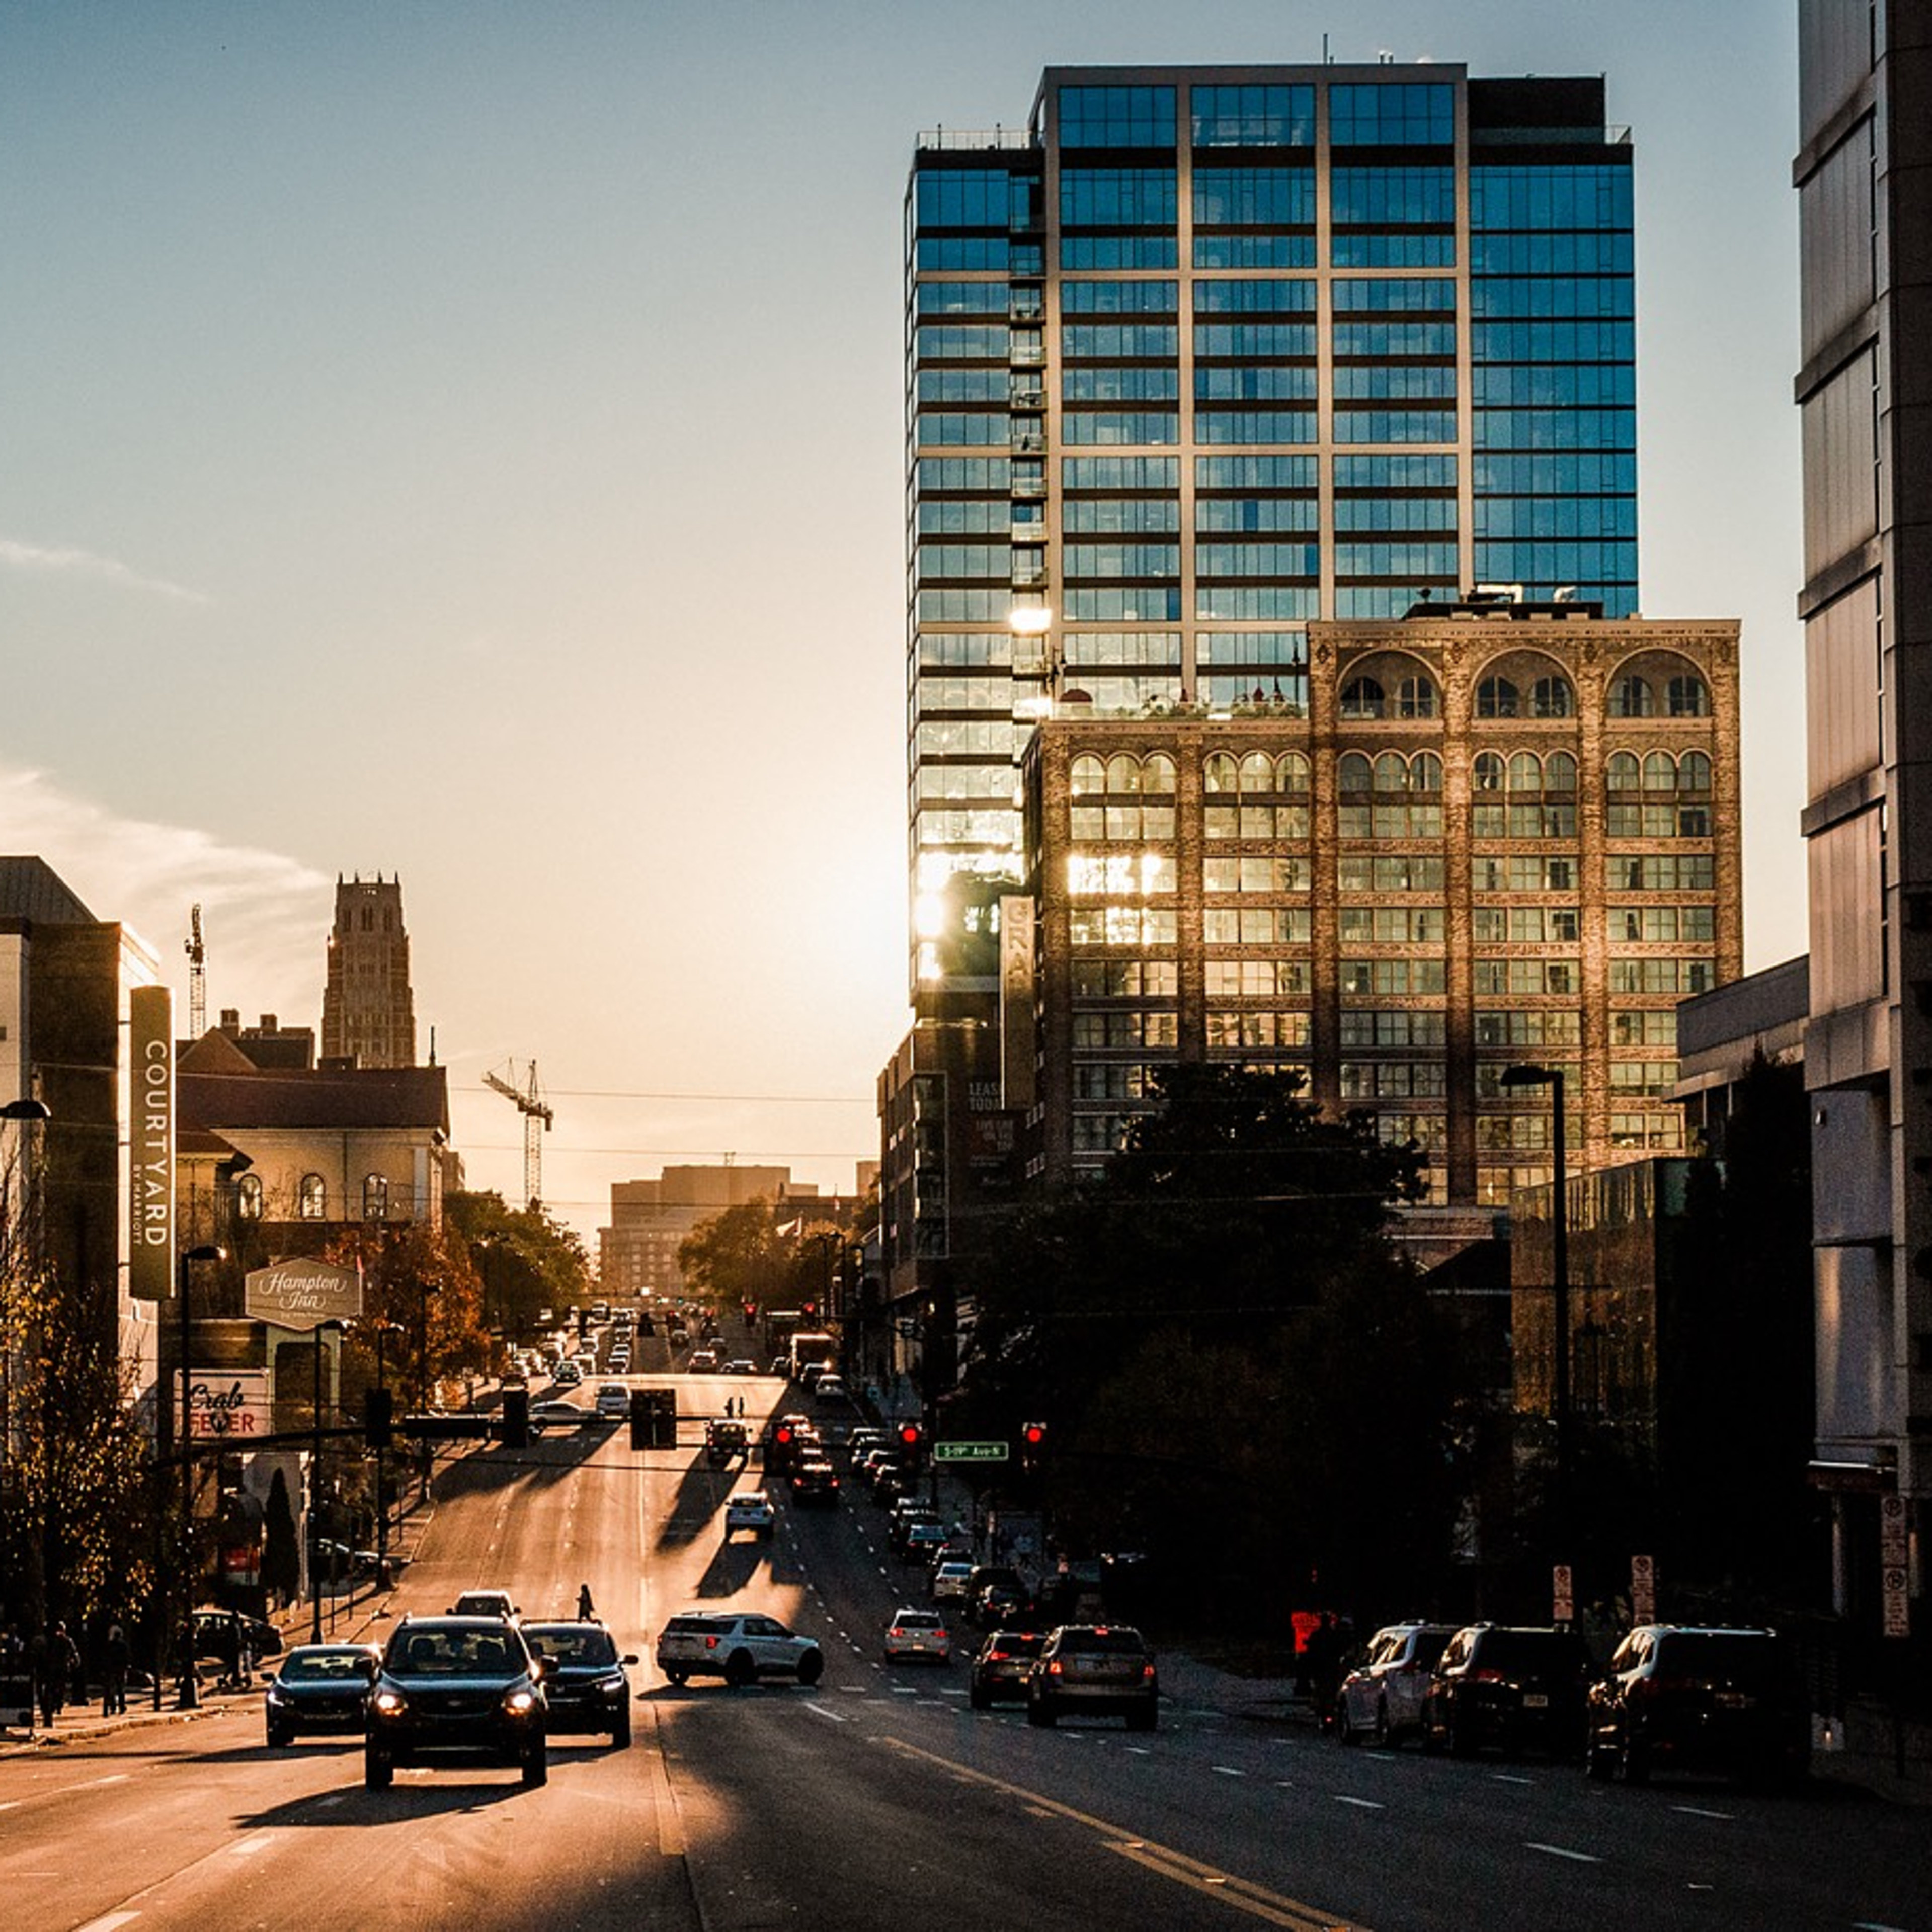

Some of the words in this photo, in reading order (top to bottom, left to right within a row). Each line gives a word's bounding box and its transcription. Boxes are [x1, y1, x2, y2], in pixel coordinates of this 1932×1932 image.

[145, 1039, 167, 1246] COURTYARD
[133, 1183, 142, 1246] MARRIOTT
[259, 1272, 347, 1295] Hampton
[279, 1291, 327, 1309] Inn
